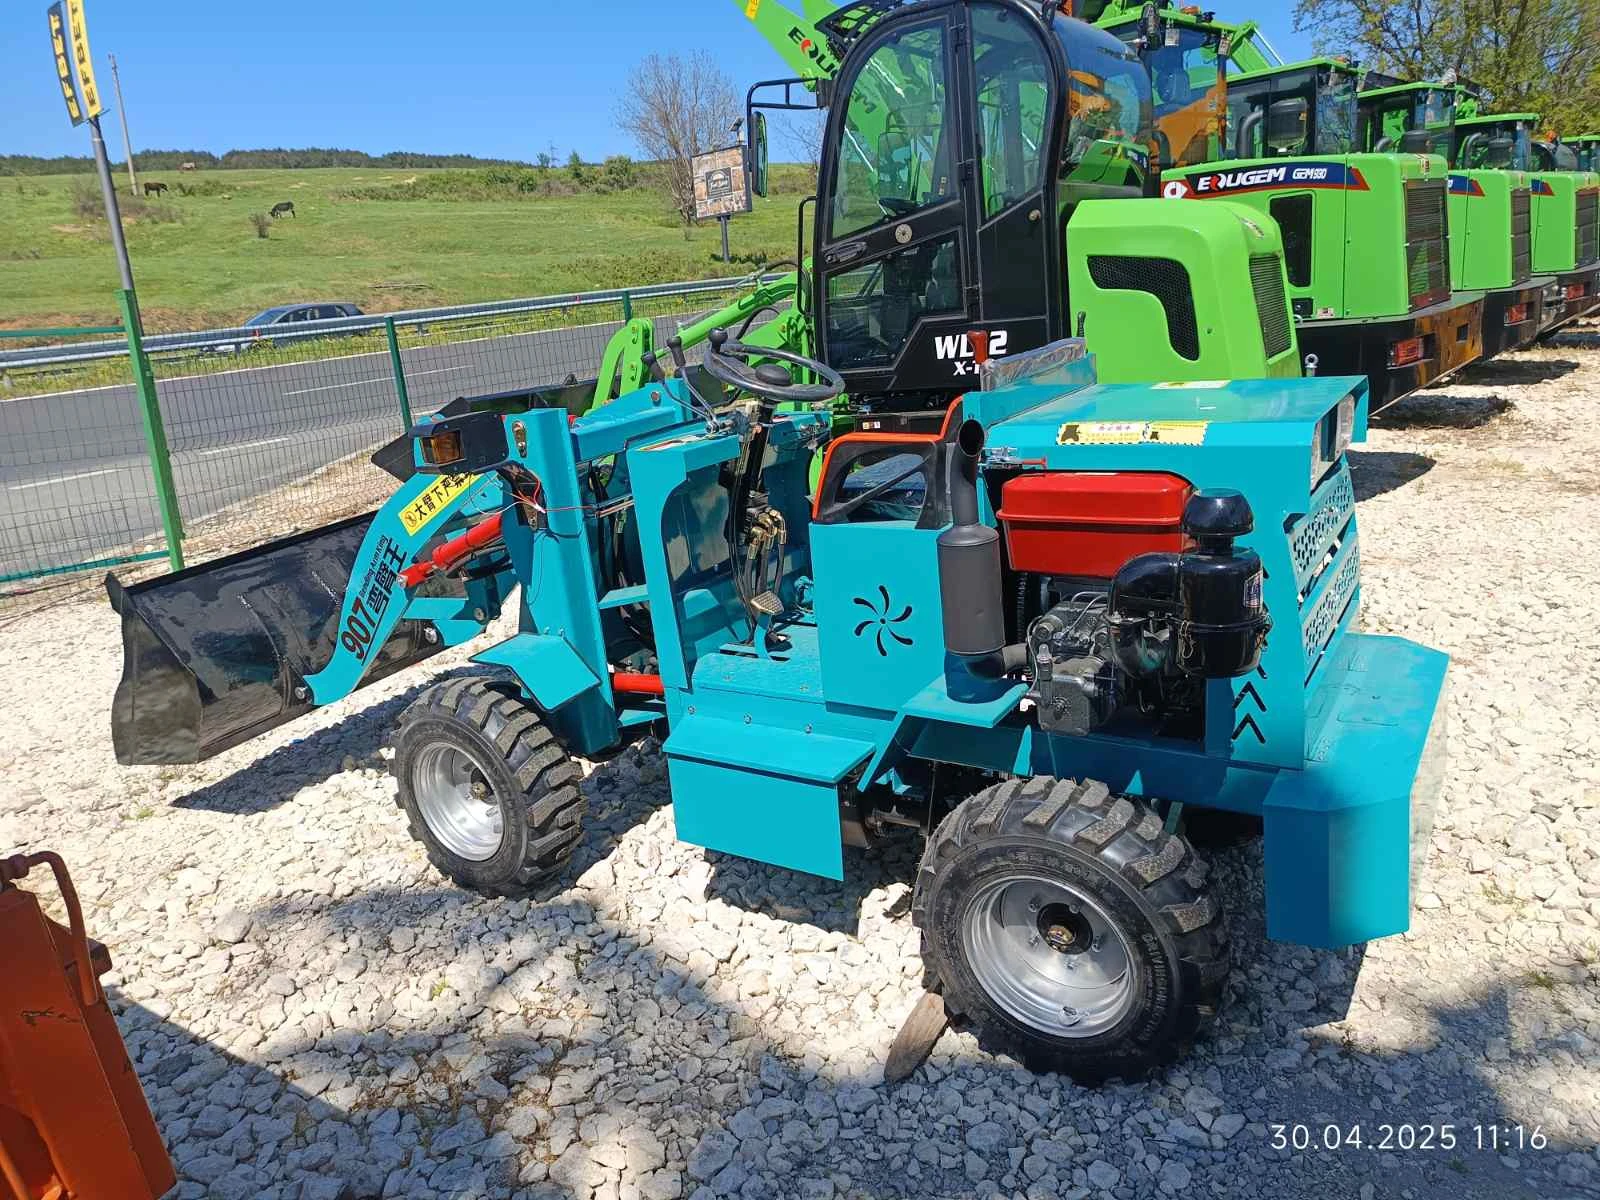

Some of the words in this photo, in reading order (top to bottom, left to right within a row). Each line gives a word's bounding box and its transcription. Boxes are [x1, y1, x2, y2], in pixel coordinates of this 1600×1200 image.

[934, 330, 1007, 360] WL2
[414, 471, 471, 520] 大臂下严禁
[341, 597, 377, 661] 907
